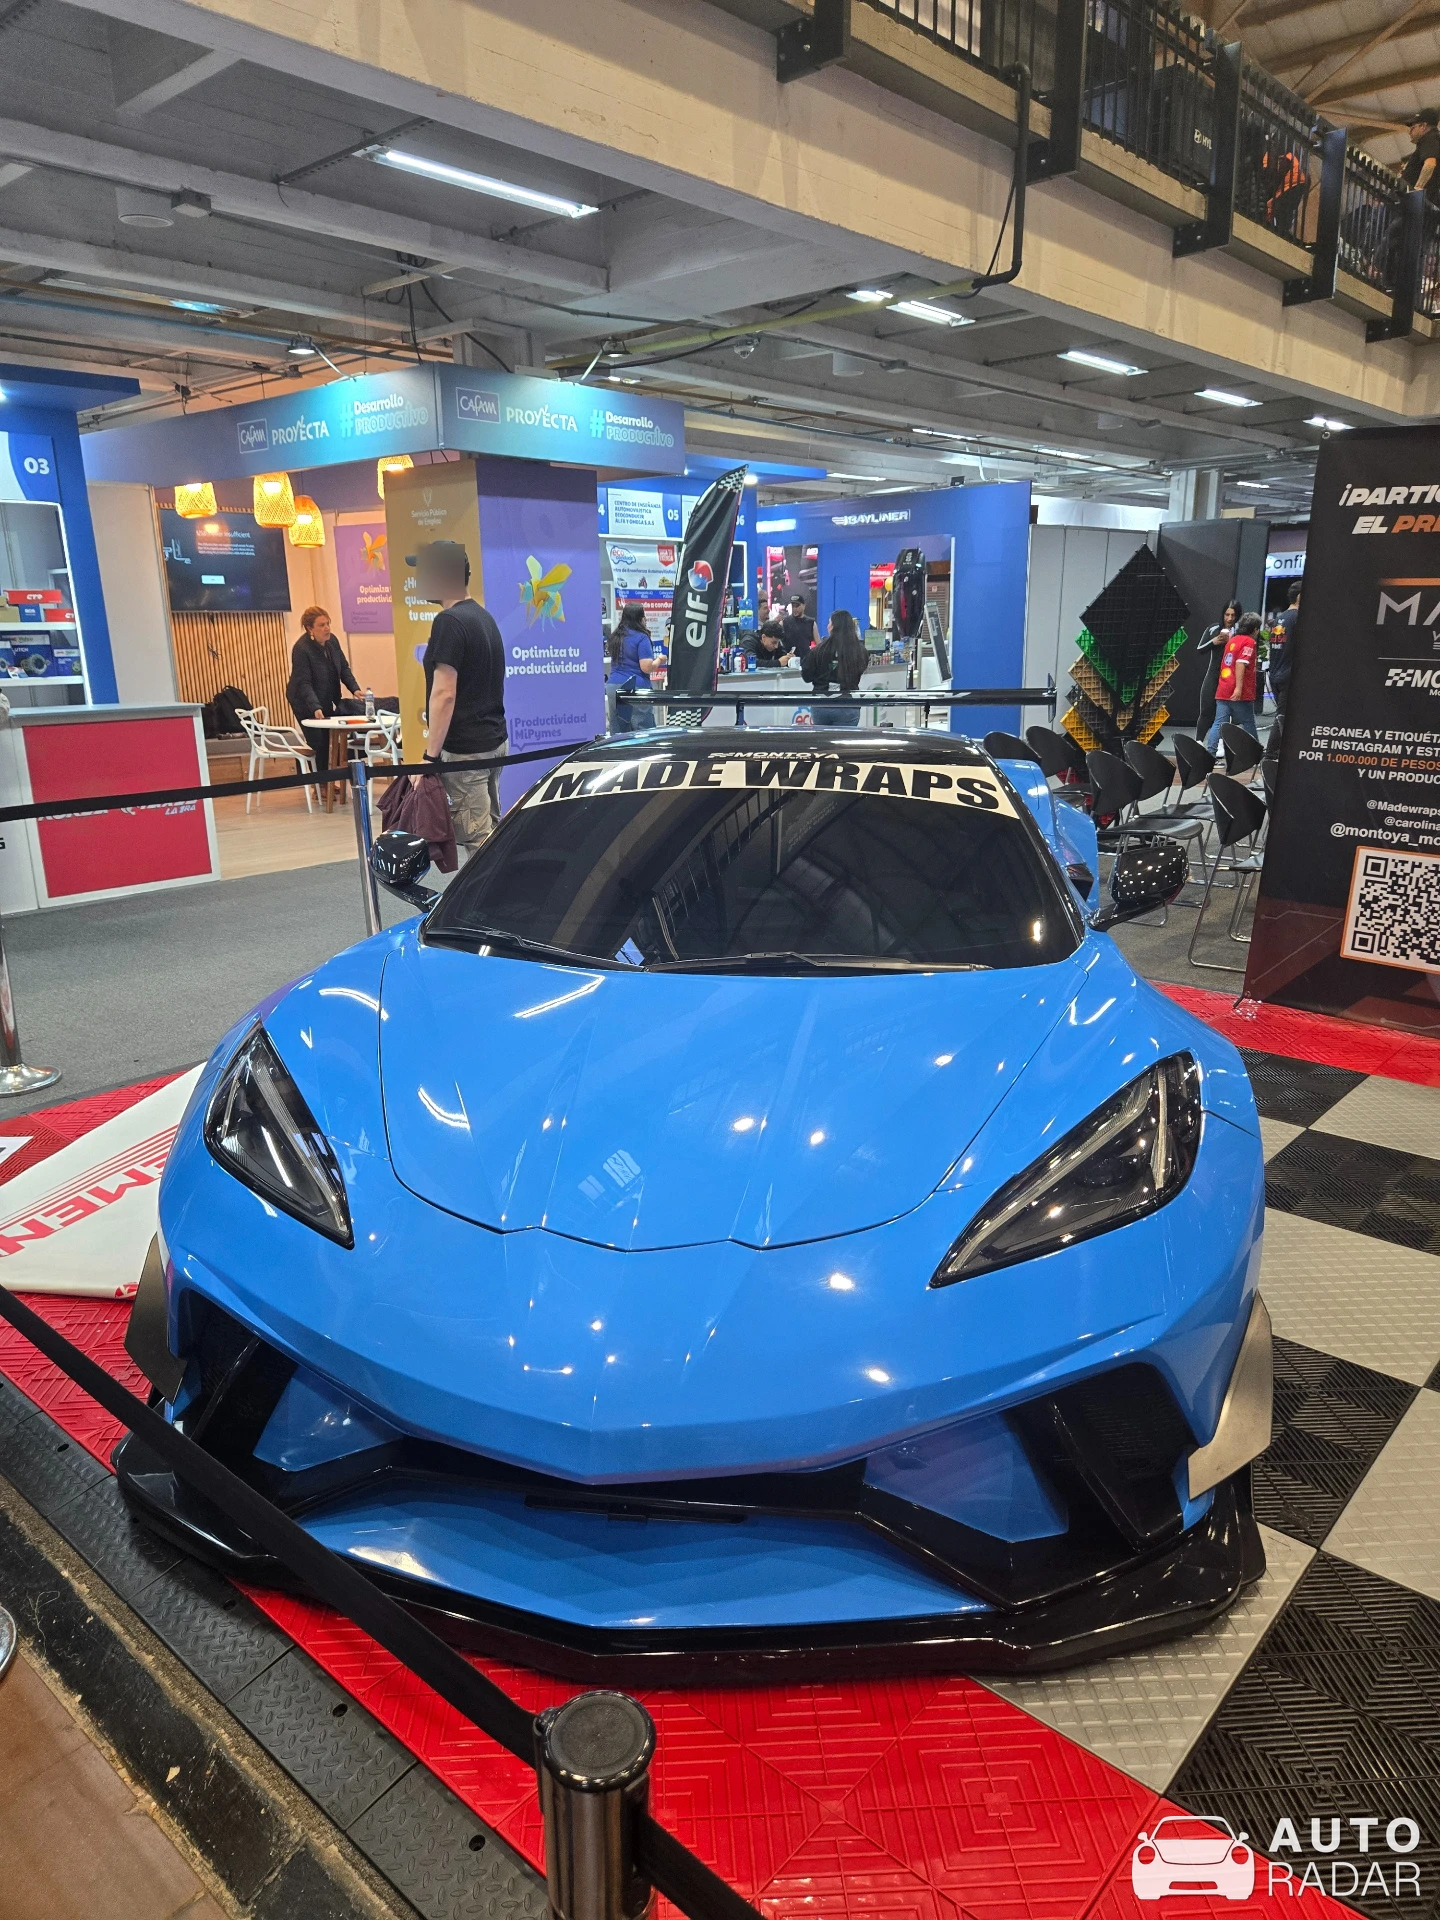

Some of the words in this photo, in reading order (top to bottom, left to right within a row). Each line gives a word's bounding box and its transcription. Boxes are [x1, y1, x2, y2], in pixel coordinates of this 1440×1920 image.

[354, 393, 404, 416] Desarrollo
[506, 404, 578, 433] PROYECTA
[605, 410, 654, 429] Desarrollo
[271, 415, 330, 446] PROYECTA
[23, 457, 51, 476] 03
[1338, 483, 1440, 507] ¡PARTI
[411, 510, 429, 518] Servicio
[667, 509, 679, 520] 05
[844, 511, 909, 526] BAYLINER
[1351, 514, 1389, 535] EL
[359, 584, 390, 595] Optimiza
[685, 591, 709, 648] elf
[512, 645, 567, 661] Optimiza
[568, 646, 580, 657] tu
[505, 661, 588, 678] productividad
[514, 713, 587, 728] Productividad
[515, 728, 562, 741] MiPymes
[1311, 725, 1372, 739] ¡ESCANEA
[1374, 730, 1383, 740] Y
[733, 752, 840, 760] MONTOYA
[1312, 739, 1329, 749] DE
[1330, 740, 1402, 755] INSTAGRAM
[1405, 746, 1415, 756] Y
[1416, 746, 1440, 757] EST
[1298, 750, 1324, 761] POR
[1326, 753, 1378, 766] 1.000.000
[1380, 757, 1398, 768] DE
[1357, 768, 1366, 778] Y
[1368, 769, 1385, 780] UN
[539, 760, 727, 803] MADE
[744, 760, 1000, 810] WRAPS
[165, 807, 178, 816] LA
